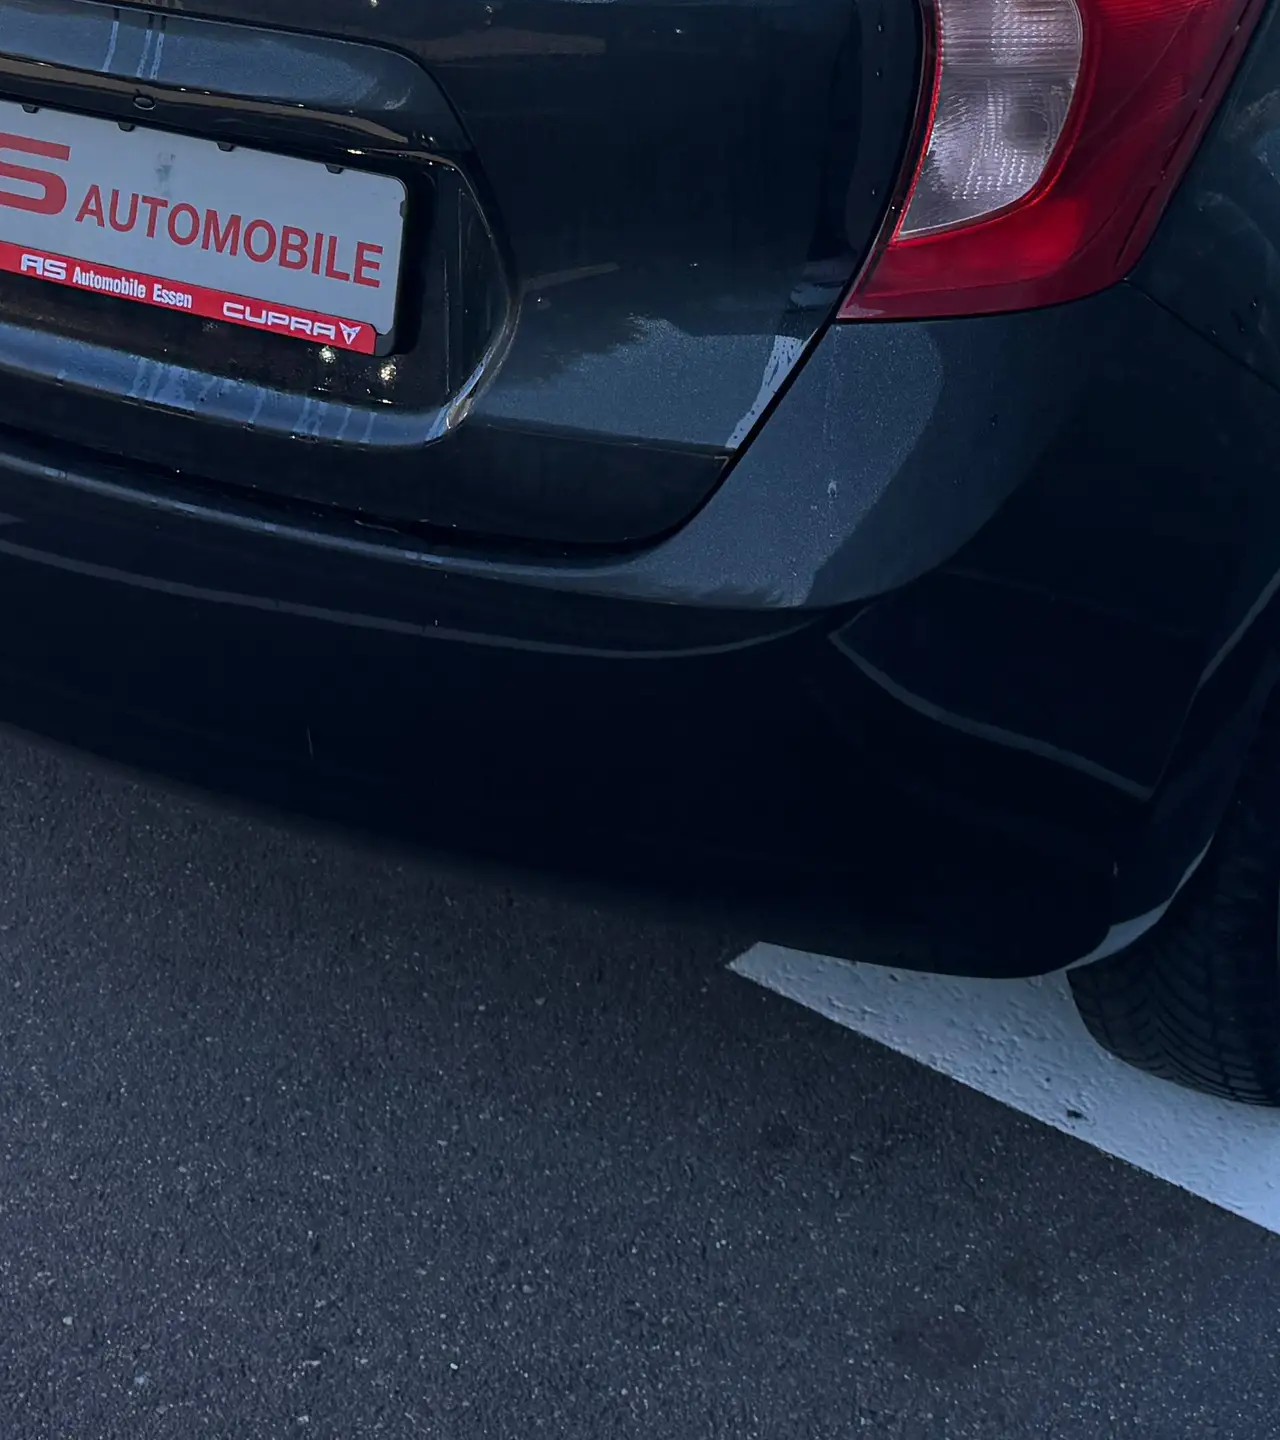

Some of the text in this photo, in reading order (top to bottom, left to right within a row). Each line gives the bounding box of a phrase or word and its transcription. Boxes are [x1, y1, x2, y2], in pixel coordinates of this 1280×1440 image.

[74, 184, 384, 288] AUTOMOBILE
[20, 254, 66, 280] AS
[72, 266, 147, 298] Automobile
[153, 283, 192, 309] Essen
[222, 301, 336, 340] CUPRA
